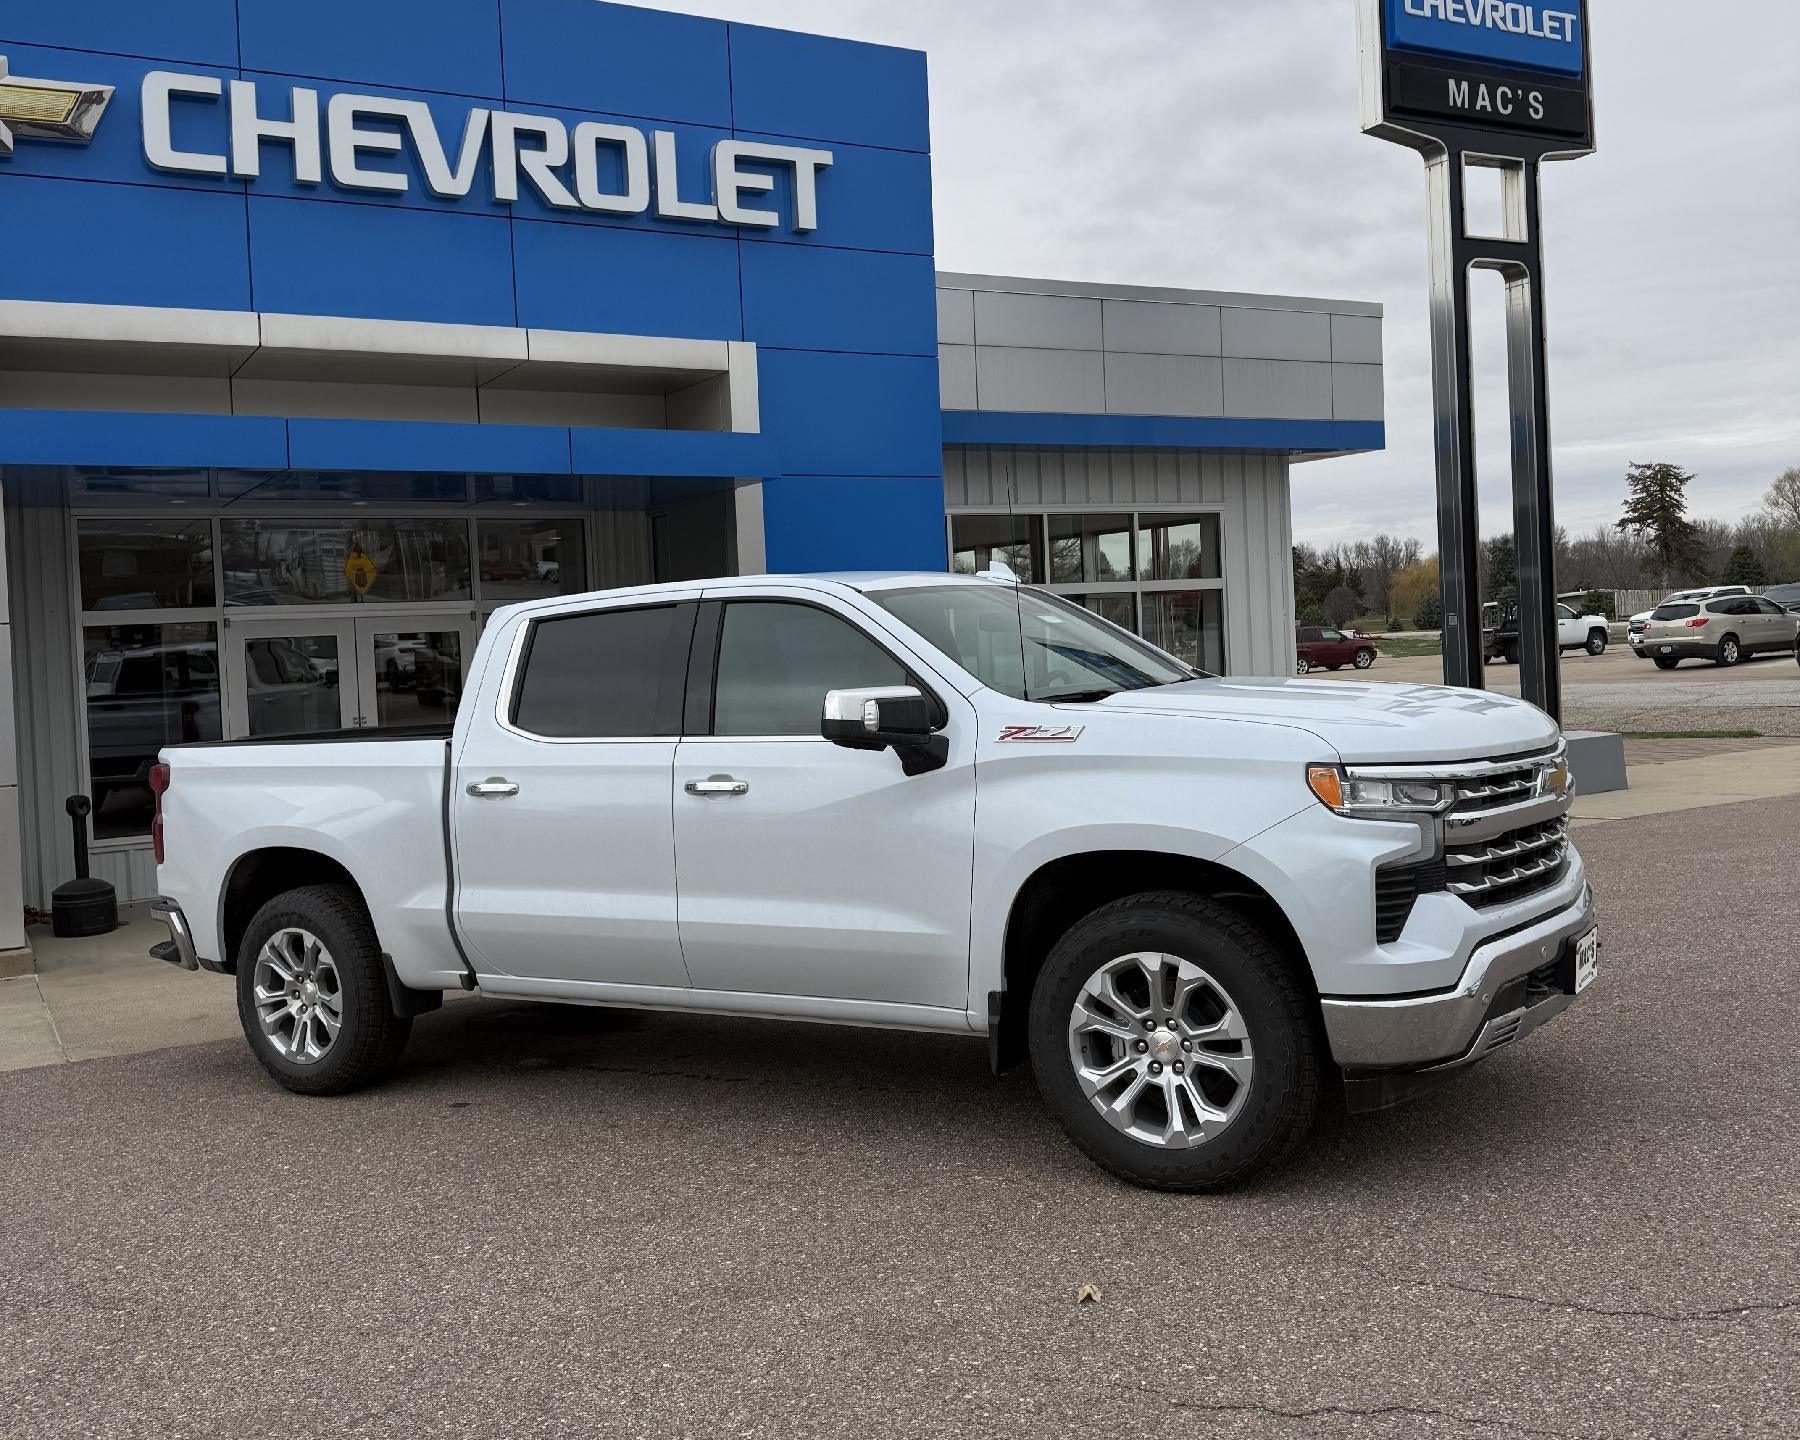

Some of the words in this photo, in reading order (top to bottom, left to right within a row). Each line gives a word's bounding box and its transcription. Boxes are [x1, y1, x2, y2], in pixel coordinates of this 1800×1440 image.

[1448, 78, 1544, 120] MAC'S
[141, 70, 834, 232] CHEVROLET
[994, 725, 1086, 743] Z71
